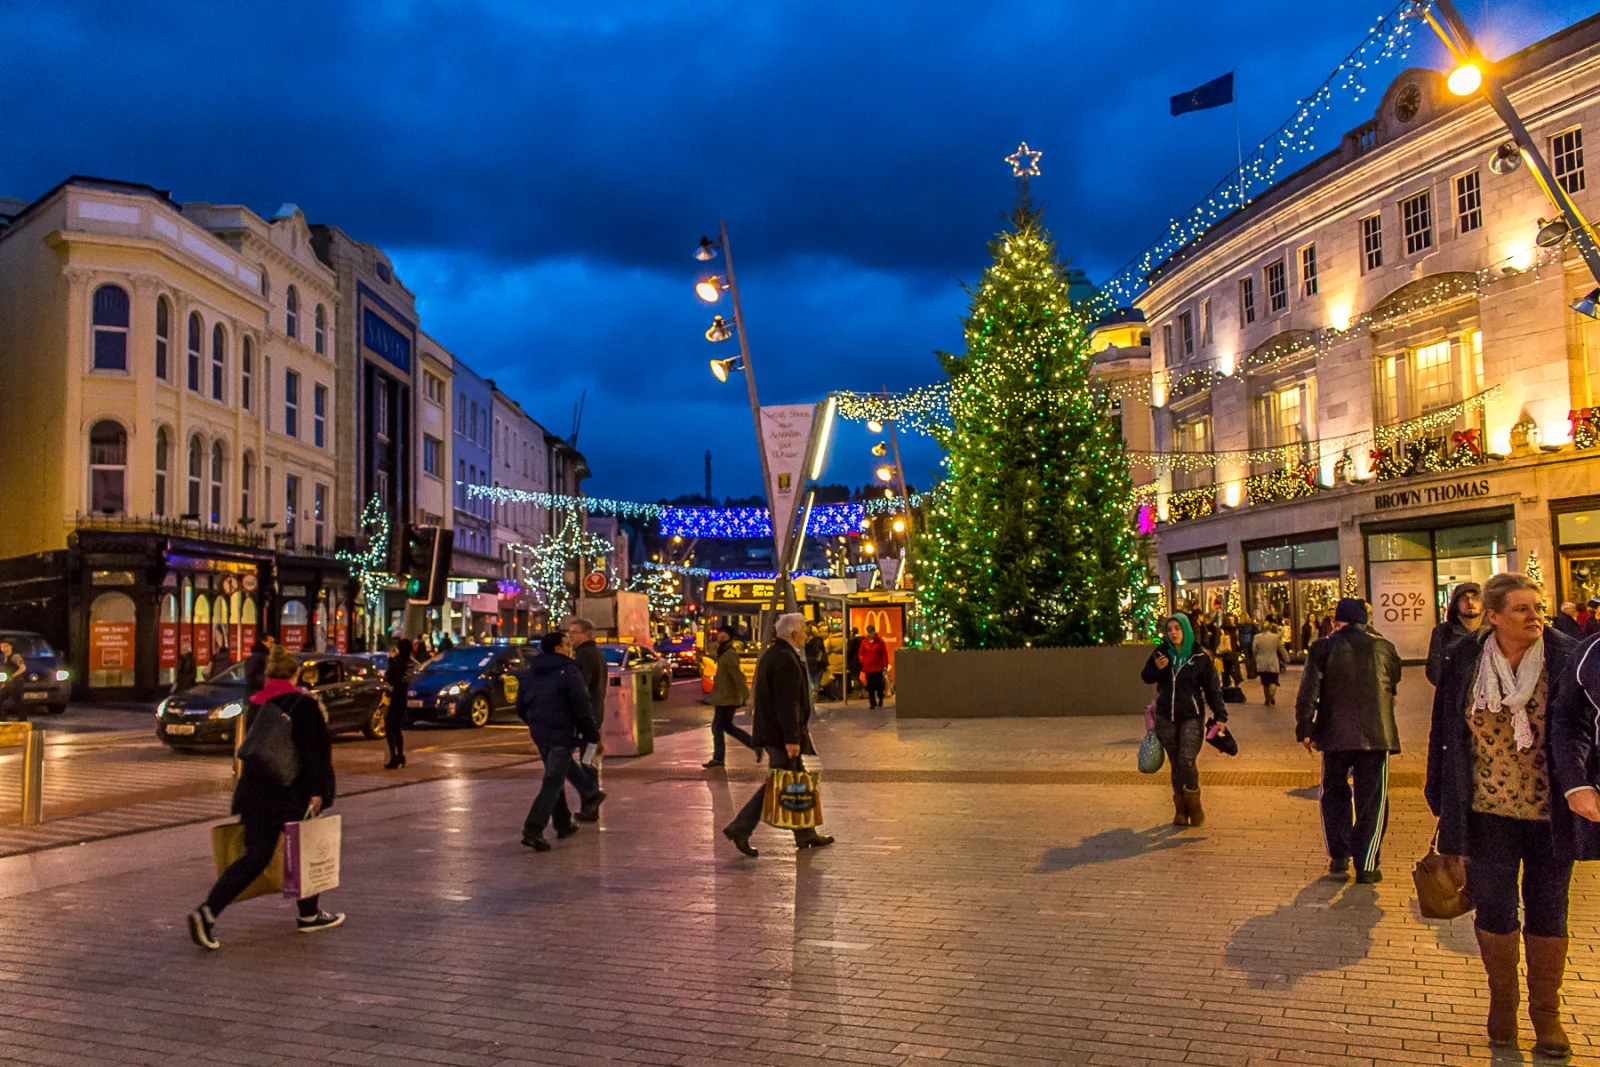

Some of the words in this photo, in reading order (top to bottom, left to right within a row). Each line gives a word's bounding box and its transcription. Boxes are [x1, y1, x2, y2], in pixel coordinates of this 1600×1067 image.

[1375, 489, 1421, 509] BROWN
[1424, 479, 1490, 502] THOMAS
[723, 584, 741, 598] 214
[1380, 592, 1426, 607] 20%
[1384, 608, 1423, 622] OFF
